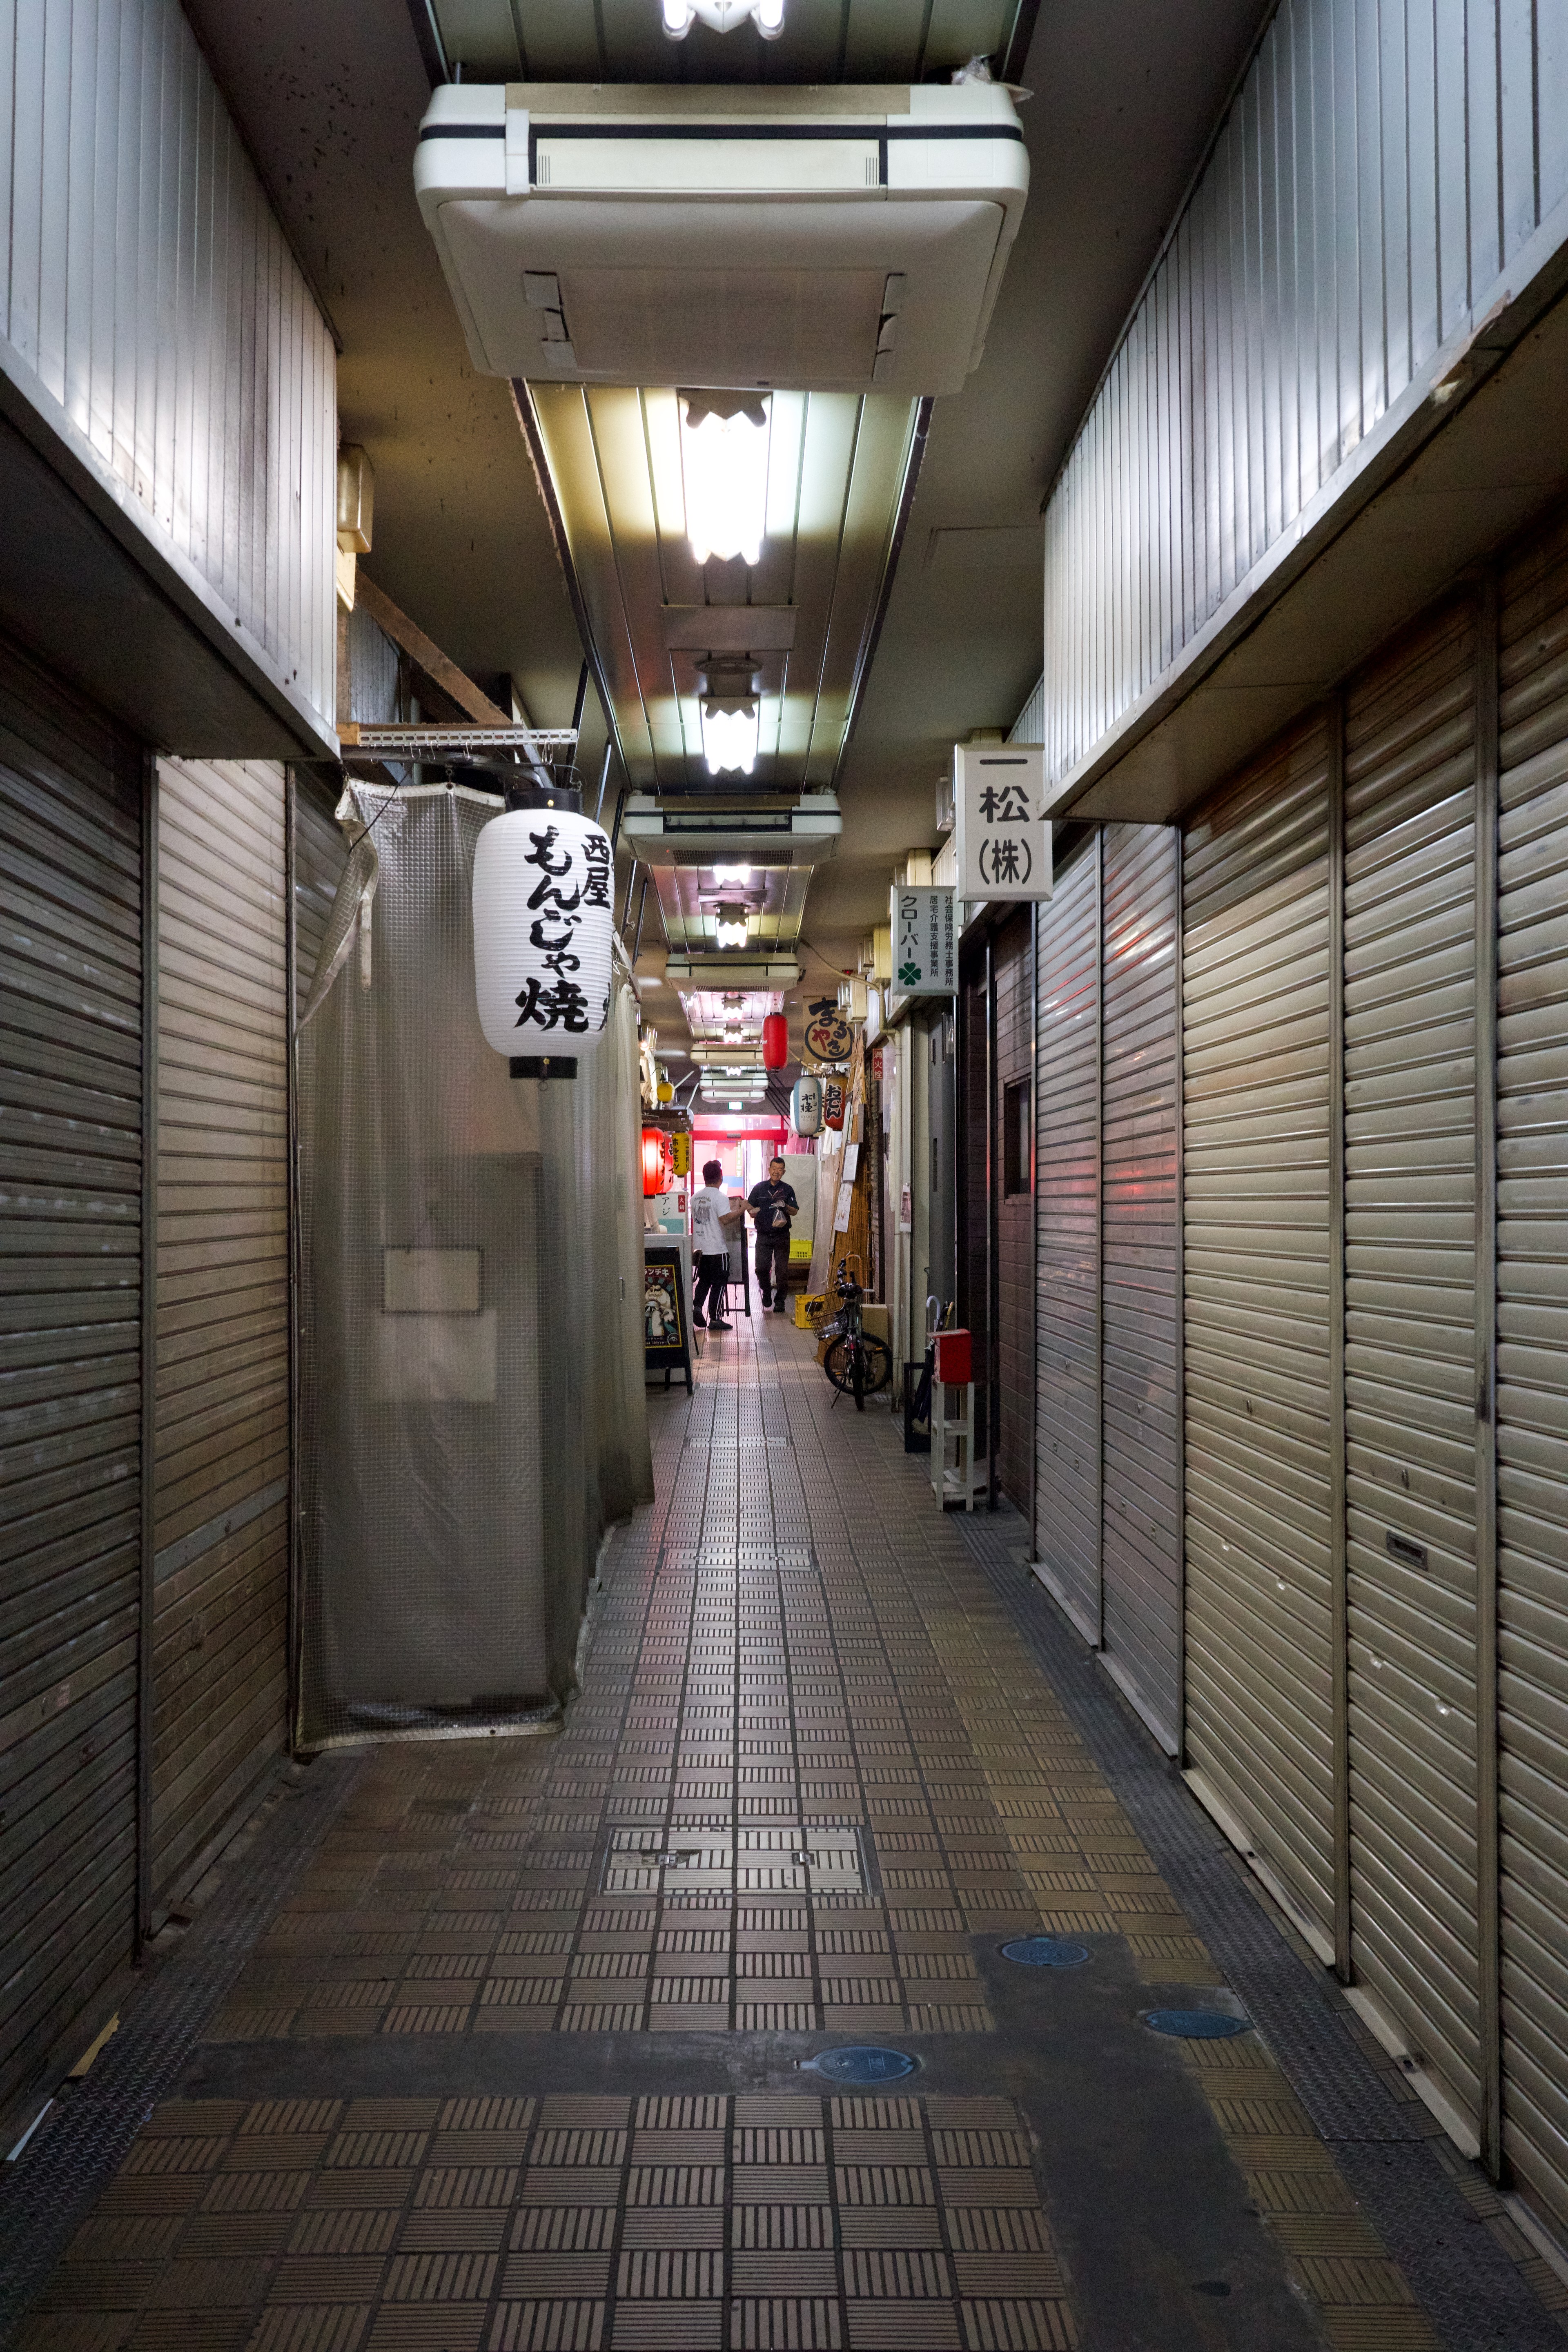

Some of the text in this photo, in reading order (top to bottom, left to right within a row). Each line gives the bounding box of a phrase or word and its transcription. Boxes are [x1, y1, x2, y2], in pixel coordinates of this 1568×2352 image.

[514, 826, 588, 1033] もんじゃ焼
[900, 895, 918, 958] クローバー
[930, 896, 938, 977] 居宅介護支援事業所
[945, 896, 953, 986] 社会保険労務士事務所
[874, 1051, 882, 1079] 消火栓
[826, 1084, 842, 1120] おでん
